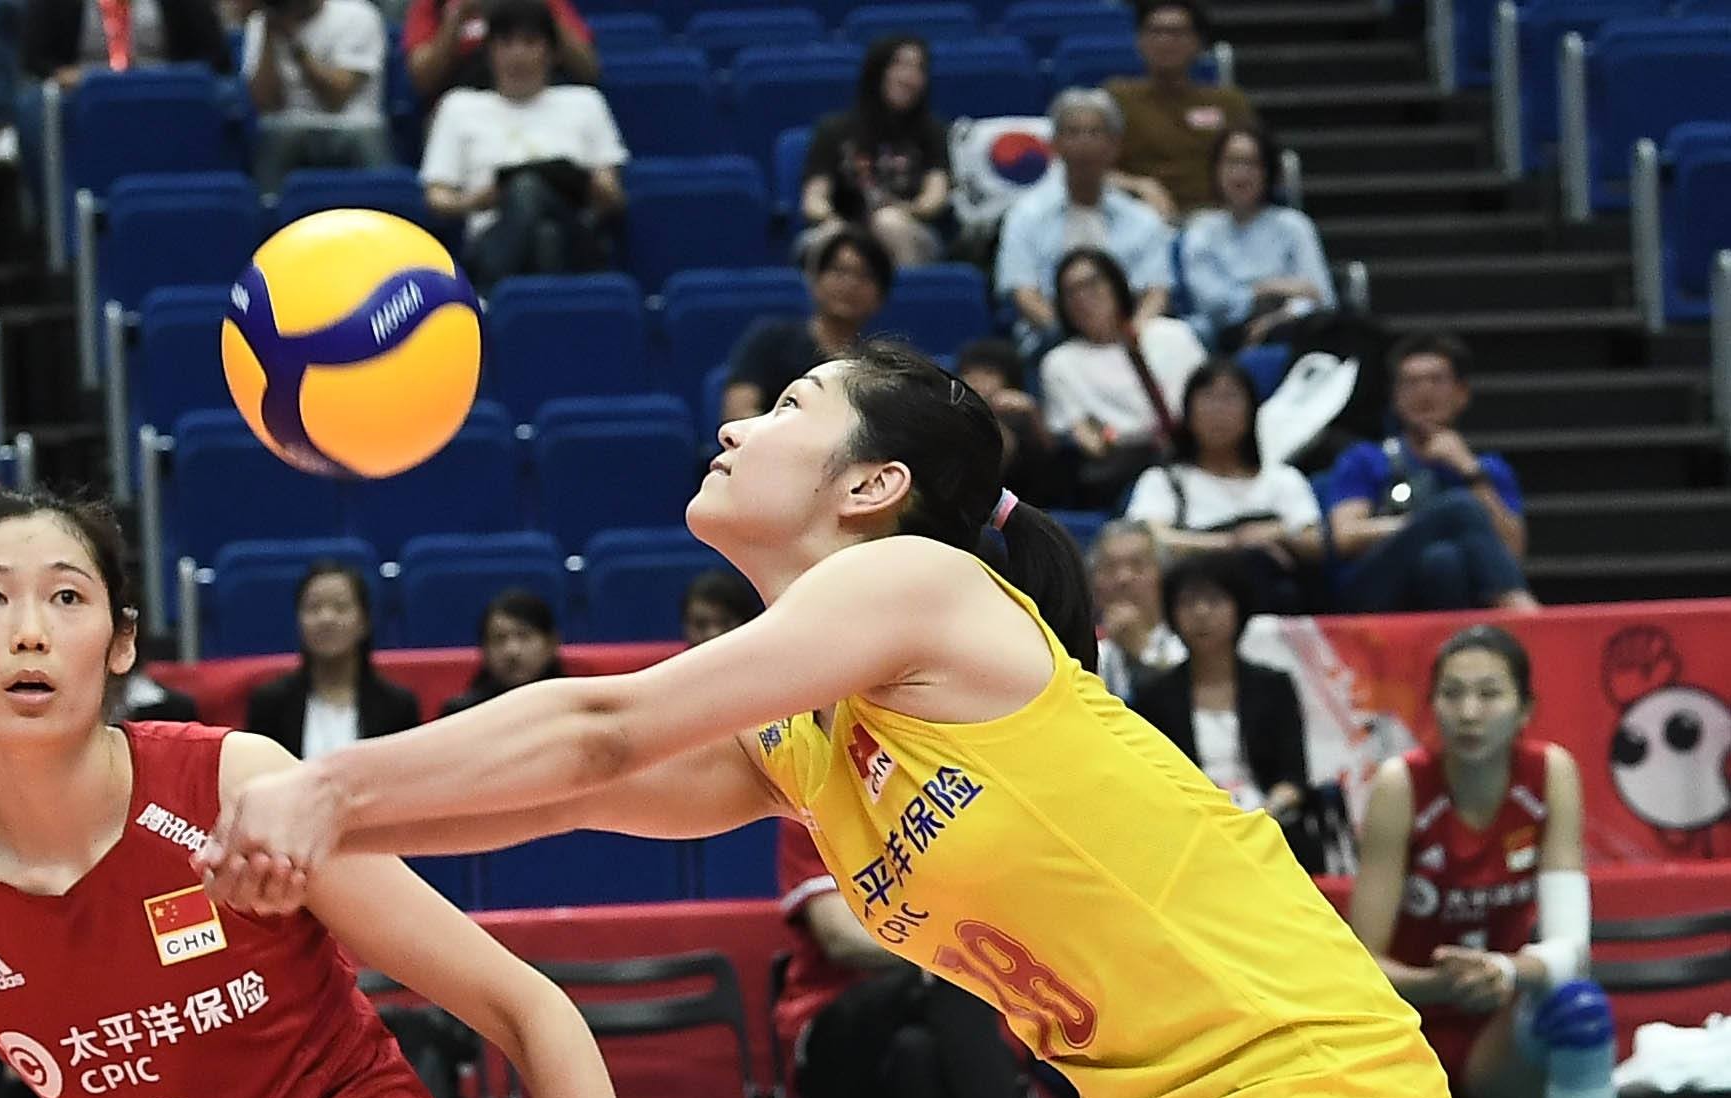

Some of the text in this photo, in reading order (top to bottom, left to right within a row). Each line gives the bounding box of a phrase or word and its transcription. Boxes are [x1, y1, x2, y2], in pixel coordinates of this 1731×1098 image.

[166, 929, 216, 955] CHN
[877, 902, 929, 944] CPIC
[60, 969, 269, 1067] 太平洋保险
[81, 1056, 160, 1094] CPIC
